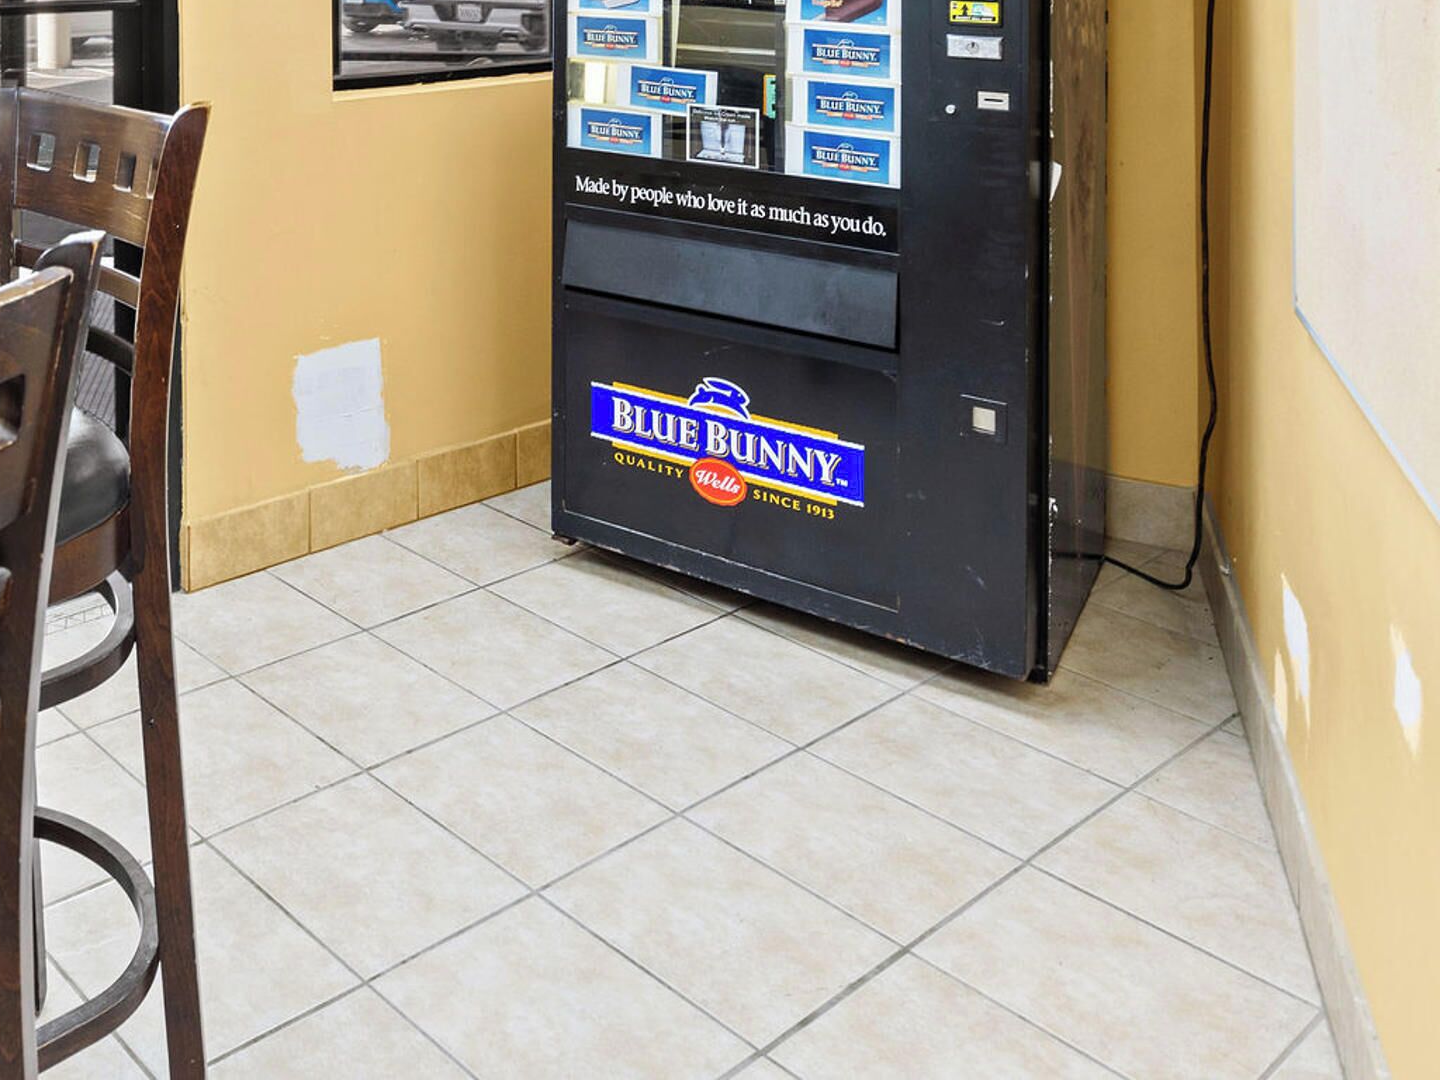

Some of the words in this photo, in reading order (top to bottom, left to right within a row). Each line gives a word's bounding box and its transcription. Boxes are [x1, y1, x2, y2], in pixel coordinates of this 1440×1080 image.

[816, 47, 840, 58] BLUE
[641, 83, 661, 94] BLUE
[820, 99, 844, 111] BLUE
[591, 125, 610, 136] BLUE
[816, 150, 840, 161] BLUE
[575, 175, 610, 195] Made
[612, 179, 629, 202] by
[630, 186, 673, 207] people
[675, 190, 705, 209] who
[707, 193, 735, 214] love
[737, 198, 748, 216] it
[750, 203, 766, 218] as
[768, 206, 810, 225] much
[813, 212, 829, 228] as
[830, 214, 861, 234] you
[862, 216, 887, 237] do.
[611, 396, 700, 452] BLUE
[705, 419, 842, 487] BUNNY
[614, 452, 684, 479] QUALITY
[695, 469, 741, 495] Wells
[753, 489, 801, 512] SINCE
[806, 503, 835, 520] 1913
